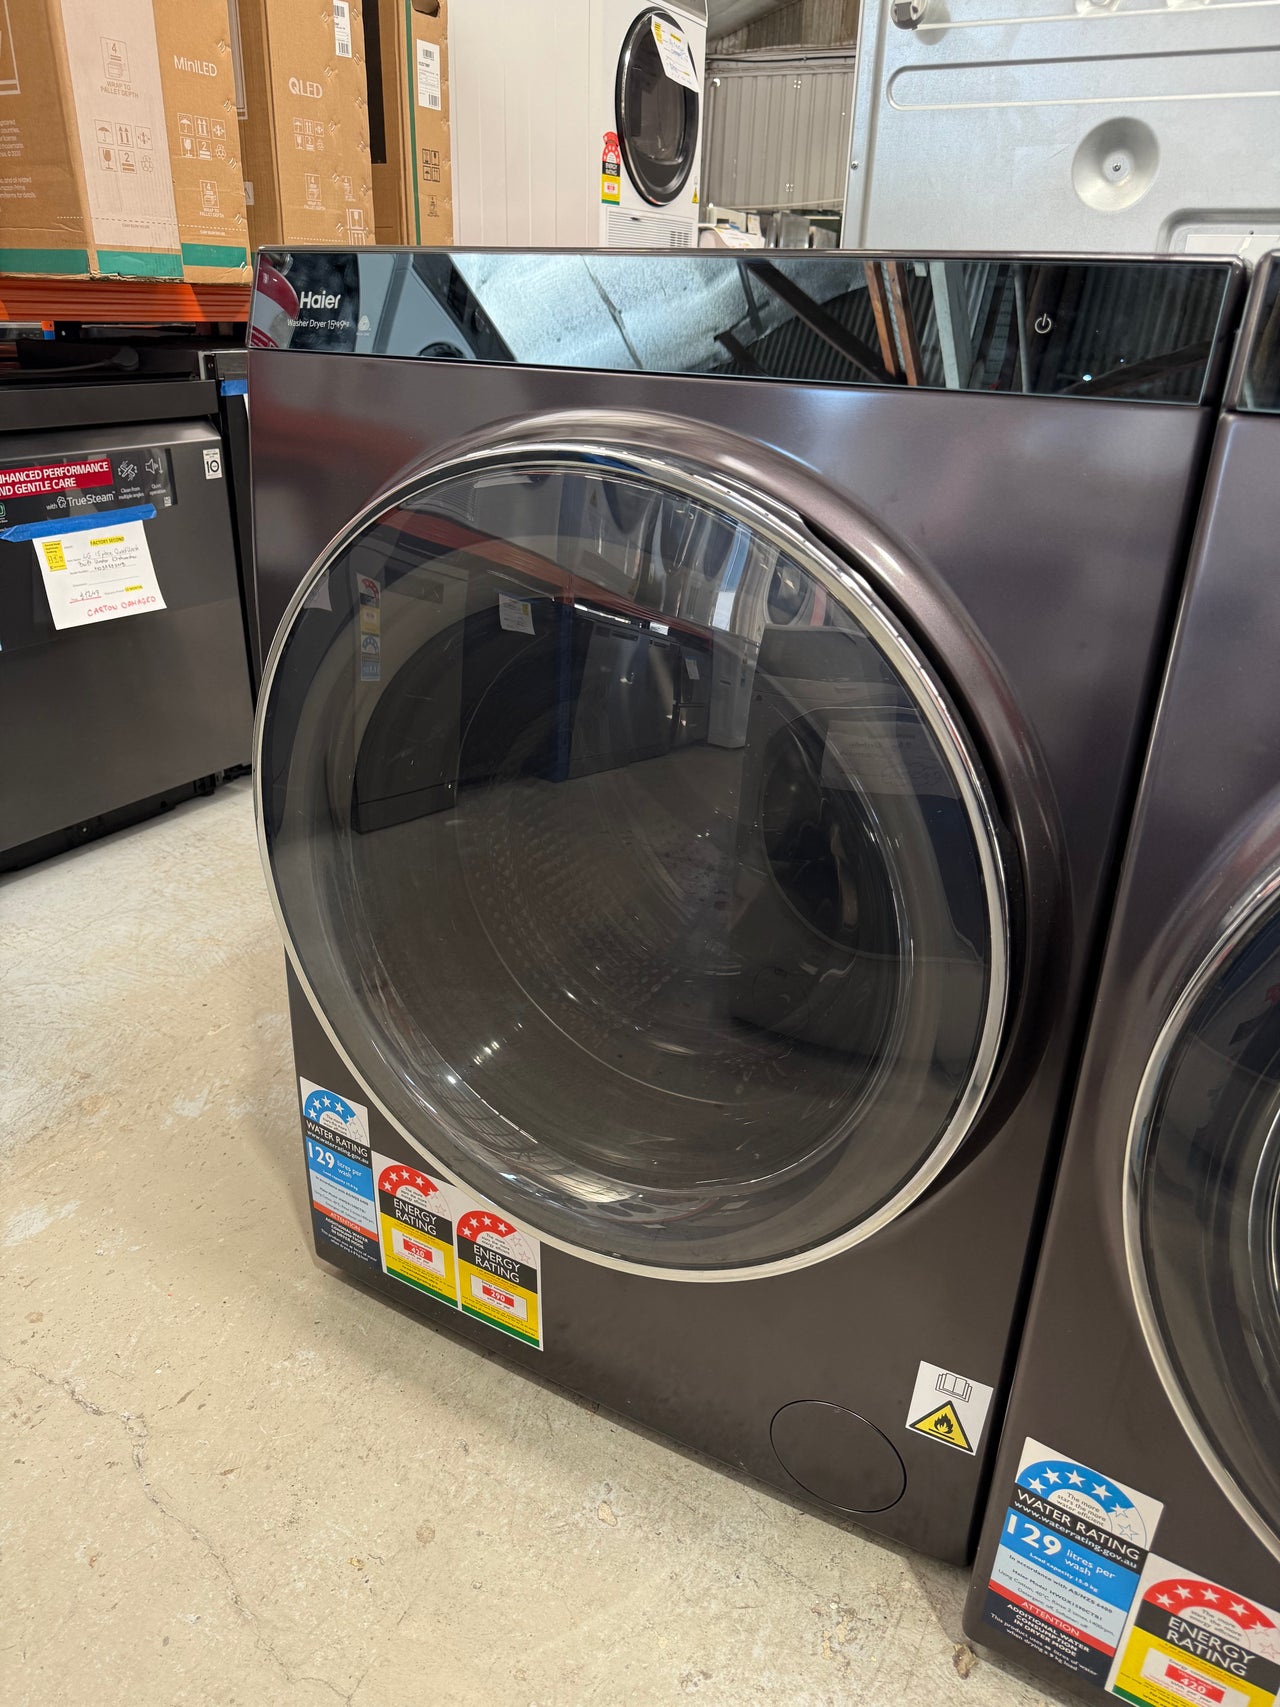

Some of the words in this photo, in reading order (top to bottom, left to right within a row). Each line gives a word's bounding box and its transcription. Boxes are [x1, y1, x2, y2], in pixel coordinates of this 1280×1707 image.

[174, 55, 218, 77] MiniLED
[288, 76, 322, 99] QLED
[124, 152, 130, 162] 2
[300, 290, 341, 309] Haier
[288, 318, 309, 327] Washer
[310, 320, 326, 329] Dryer
[44, 462, 109, 478] PERFORMANCE
[15, 480, 51, 494] GENTLE
[52, 477, 76, 490] CARE
[86, 602, 118, 617] CARTON
[120, 595, 157, 609] DAMAGED
[305, 1119, 333, 1141] WATER
[335, 1135, 368, 1158] RATING
[306, 1130, 368, 1166] www.waterrating.gov.au
[307, 1140, 335, 1171] 129
[337, 1166, 352, 1179] wash
[329, 1210, 360, 1232] ATTENTION
[393, 1197, 436, 1225] ENERGY
[395, 1208, 436, 1236] RATING
[411, 1246, 424, 1258] 420
[473, 1243, 520, 1273] ENERGY
[474, 1254, 519, 1283] RATING
[490, 1290, 505, 1302] 290
[1056, 1498, 1075, 1512] water
[1076, 1509, 1104, 1527] efficient
[1057, 1493, 1074, 1505] stars
[1074, 1502, 1086, 1512] the
[1087, 1509, 1106, 1522] more
[1066, 1492, 1079, 1502] The
[1080, 1500, 1099, 1513] more
[1006, 1513, 1063, 1559] 129
[1013, 1500, 1137, 1570] www.waterrating.gov.au
[1015, 1488, 1073, 1526] WATER
[1075, 1520, 1140, 1561] RATING
[1029, 1551, 1045, 1564] Load
[1046, 1561, 1073, 1579] capacity
[1063, 1556, 1091, 1576] wash
[1066, 1548, 1093, 1568] litres
[1095, 1564, 1115, 1582] per
[1006, 1603, 1058, 1635] ADDITIONAL
[1058, 1632, 1090, 1653] WATER
[1020, 1599, 1080, 1637] ATTENTION
[1188, 1614, 1211, 1628] energy
[1213, 1625, 1240, 1641] efficient
[1190, 1610, 1206, 1620] stars
[1210, 1618, 1220, 1627] the
[1223, 1625, 1242, 1637] more
[1201, 1608, 1214, 1618] The
[1217, 1616, 1236, 1629] more
[1013, 1618, 1022, 1627] IN
[1023, 1624, 1050, 1642] DRYER
[1050, 1639, 1077, 1658] MODE
[1015, 1613, 1077, 1652] CONSUMPTION
[1167, 1615, 1255, 1668] ENERGY
[1166, 1628, 1247, 1677] RATING
[1180, 1675, 1206, 1695] 420
